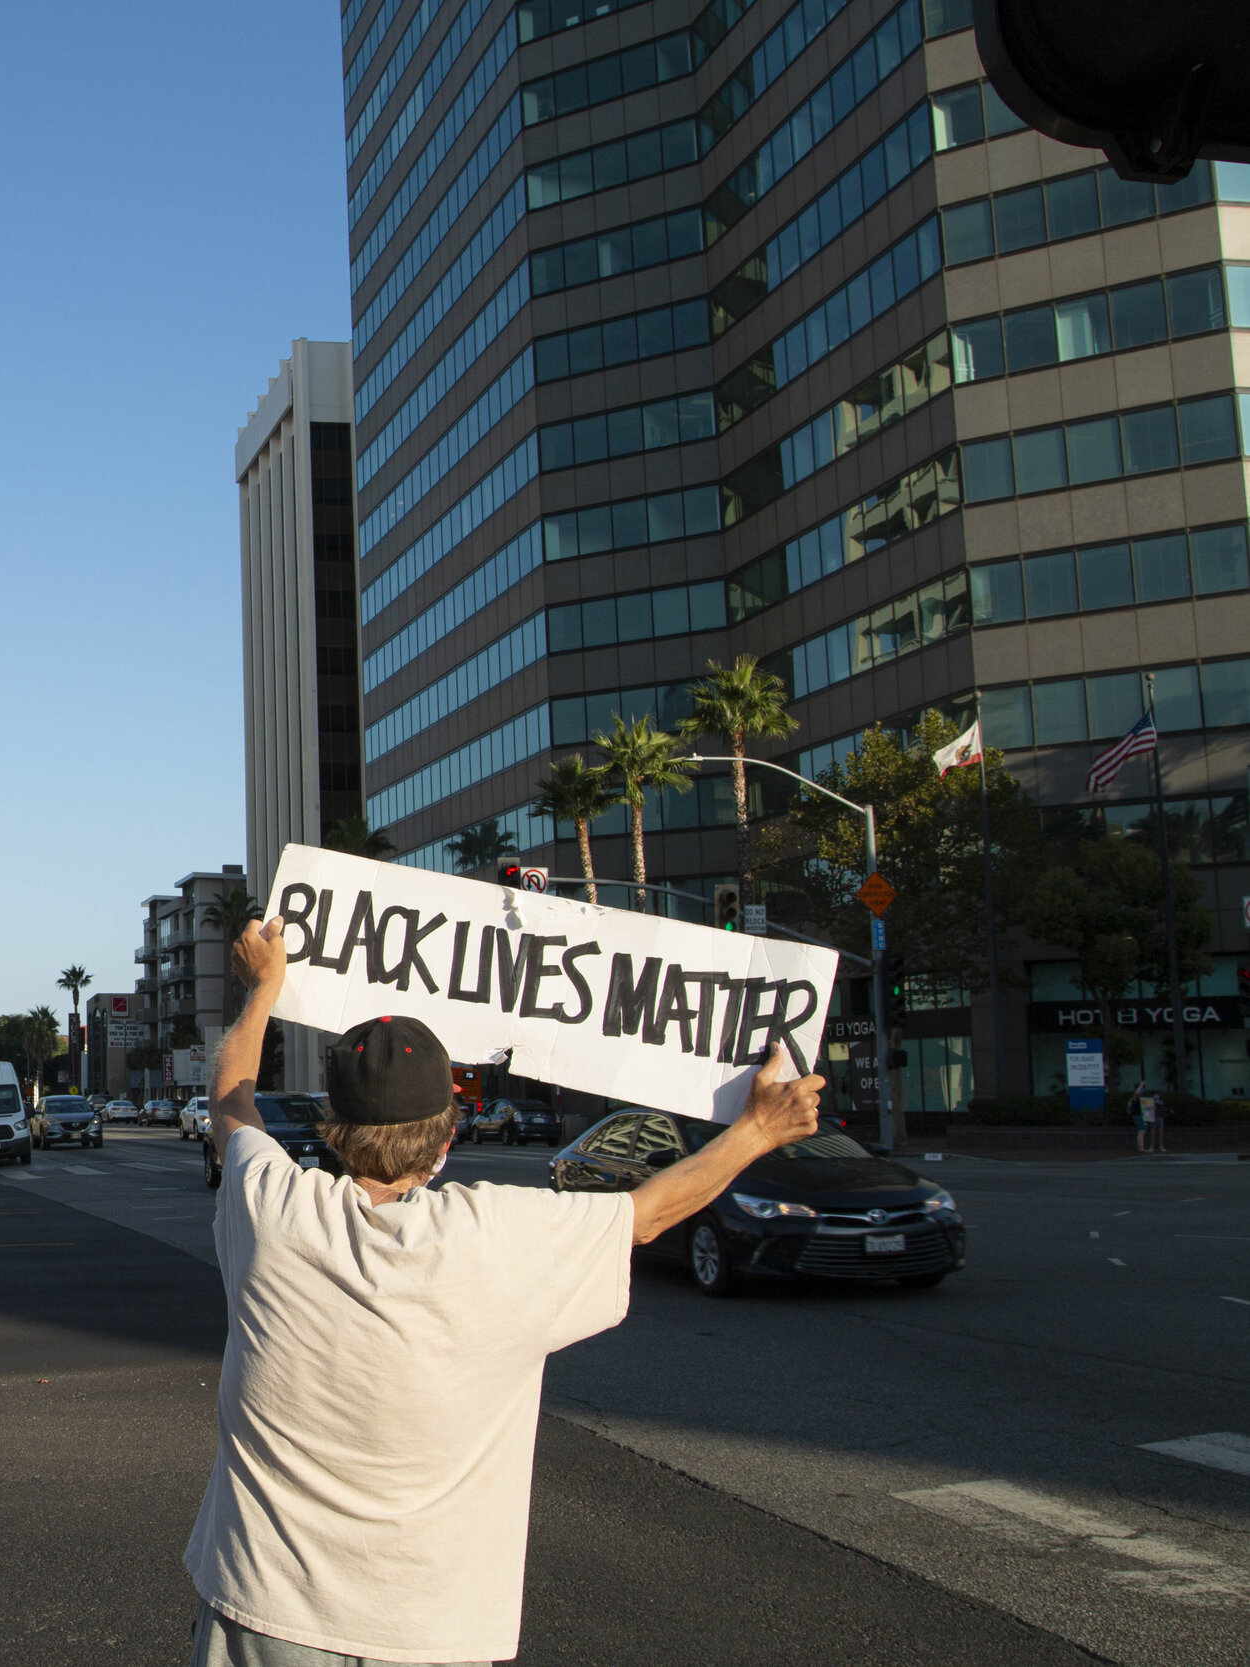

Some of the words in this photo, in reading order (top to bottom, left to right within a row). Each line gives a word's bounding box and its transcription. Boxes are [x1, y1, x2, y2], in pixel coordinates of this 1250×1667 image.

[279, 881, 449, 994] BLACK
[448, 920, 601, 1024] LIVES
[602, 952, 818, 1078] MATTER
[1146, 1006, 1221, 1024] YOGA
[846, 1021, 877, 1036] YOGA
[855, 1057, 871, 1069] WE
[860, 1077, 880, 1089] OPE
